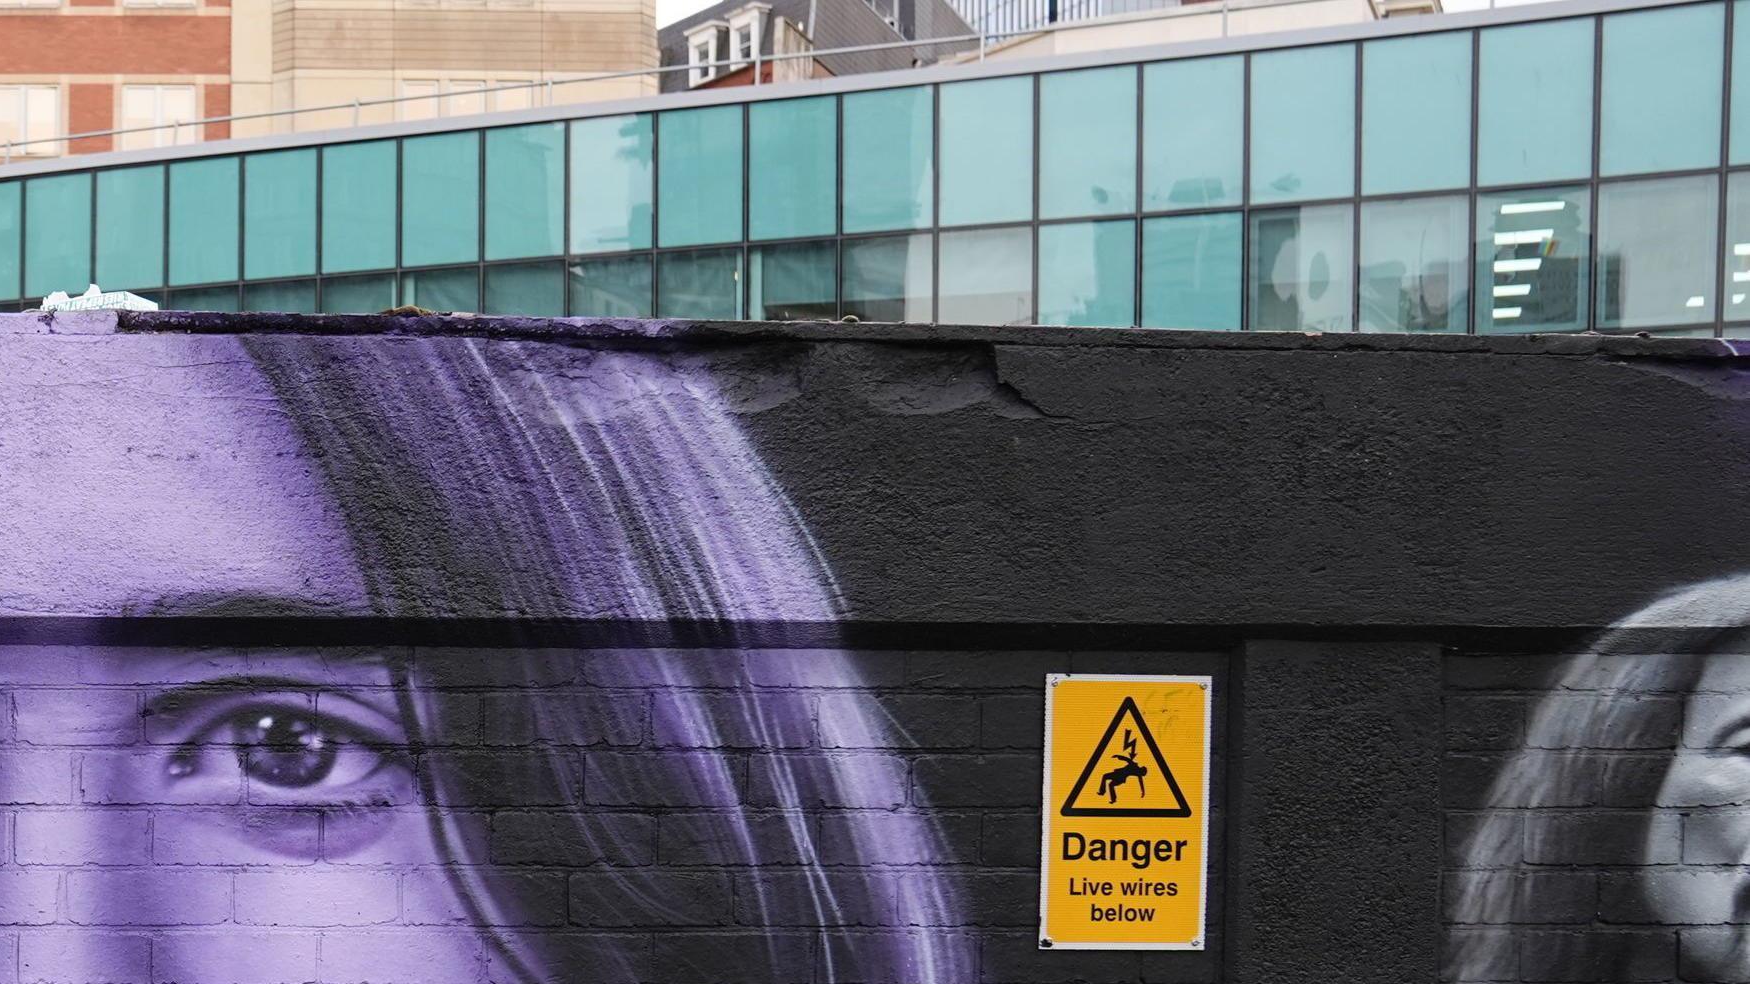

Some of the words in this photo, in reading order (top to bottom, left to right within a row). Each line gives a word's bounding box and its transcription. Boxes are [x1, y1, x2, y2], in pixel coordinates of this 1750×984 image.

[1062, 832, 1188, 869] Danger
[1069, 877, 1113, 896] Live
[1120, 877, 1178, 896] wires
[1090, 904, 1155, 922] below
